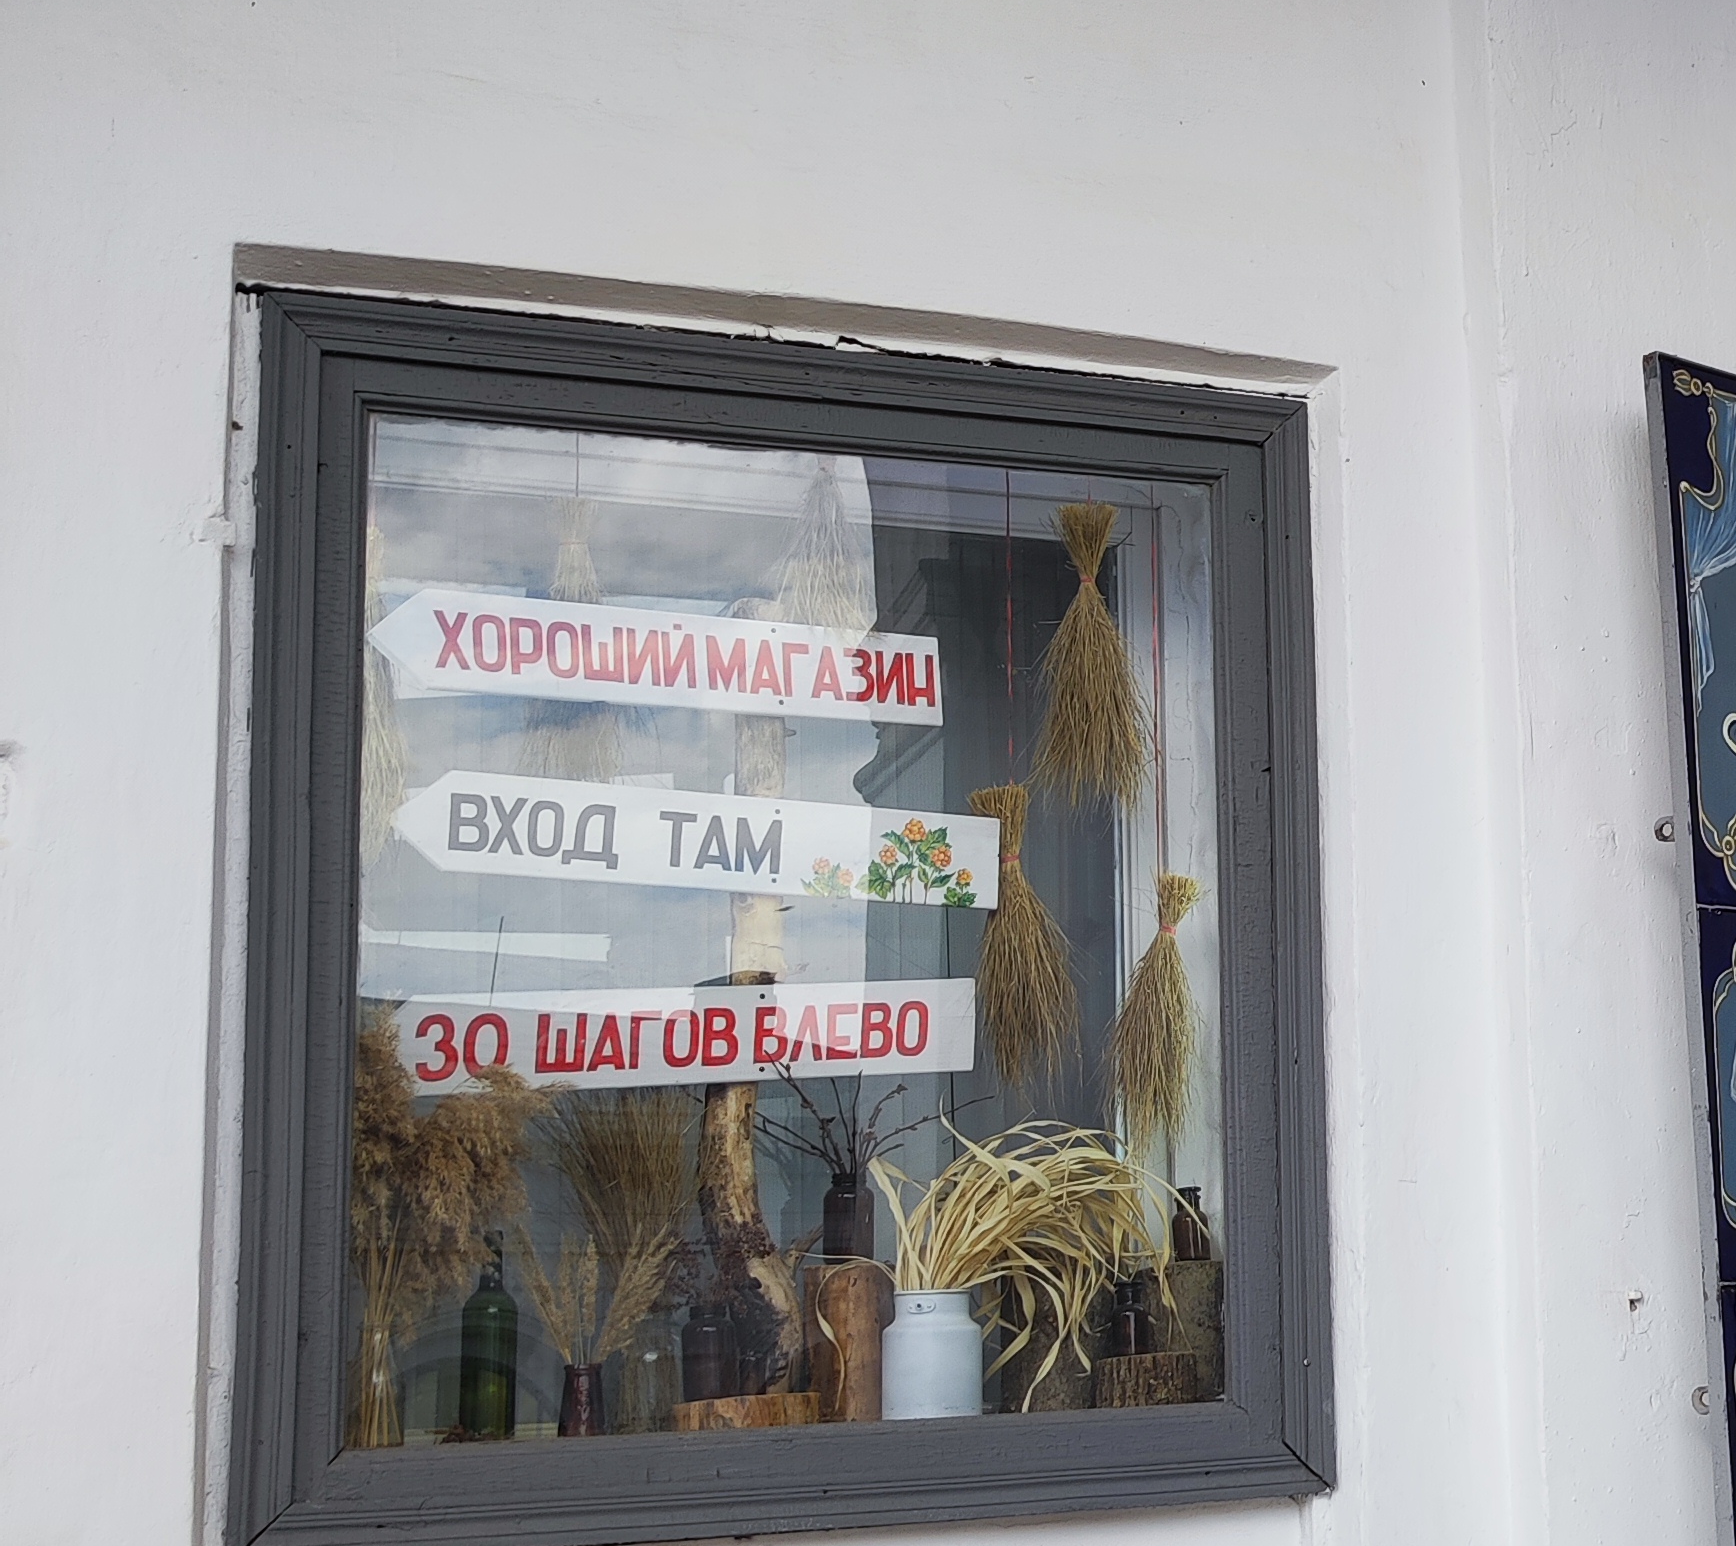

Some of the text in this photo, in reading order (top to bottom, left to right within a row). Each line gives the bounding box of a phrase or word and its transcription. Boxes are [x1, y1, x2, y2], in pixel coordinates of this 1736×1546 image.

[433, 609, 937, 708] ХОРОШИЙ МАГАЗИН
[447, 792, 783, 876] ВХОД ТАМ
[534, 1006, 740, 1074] ШАГОВ
[754, 1000, 930, 1065] ВЛЕВО
